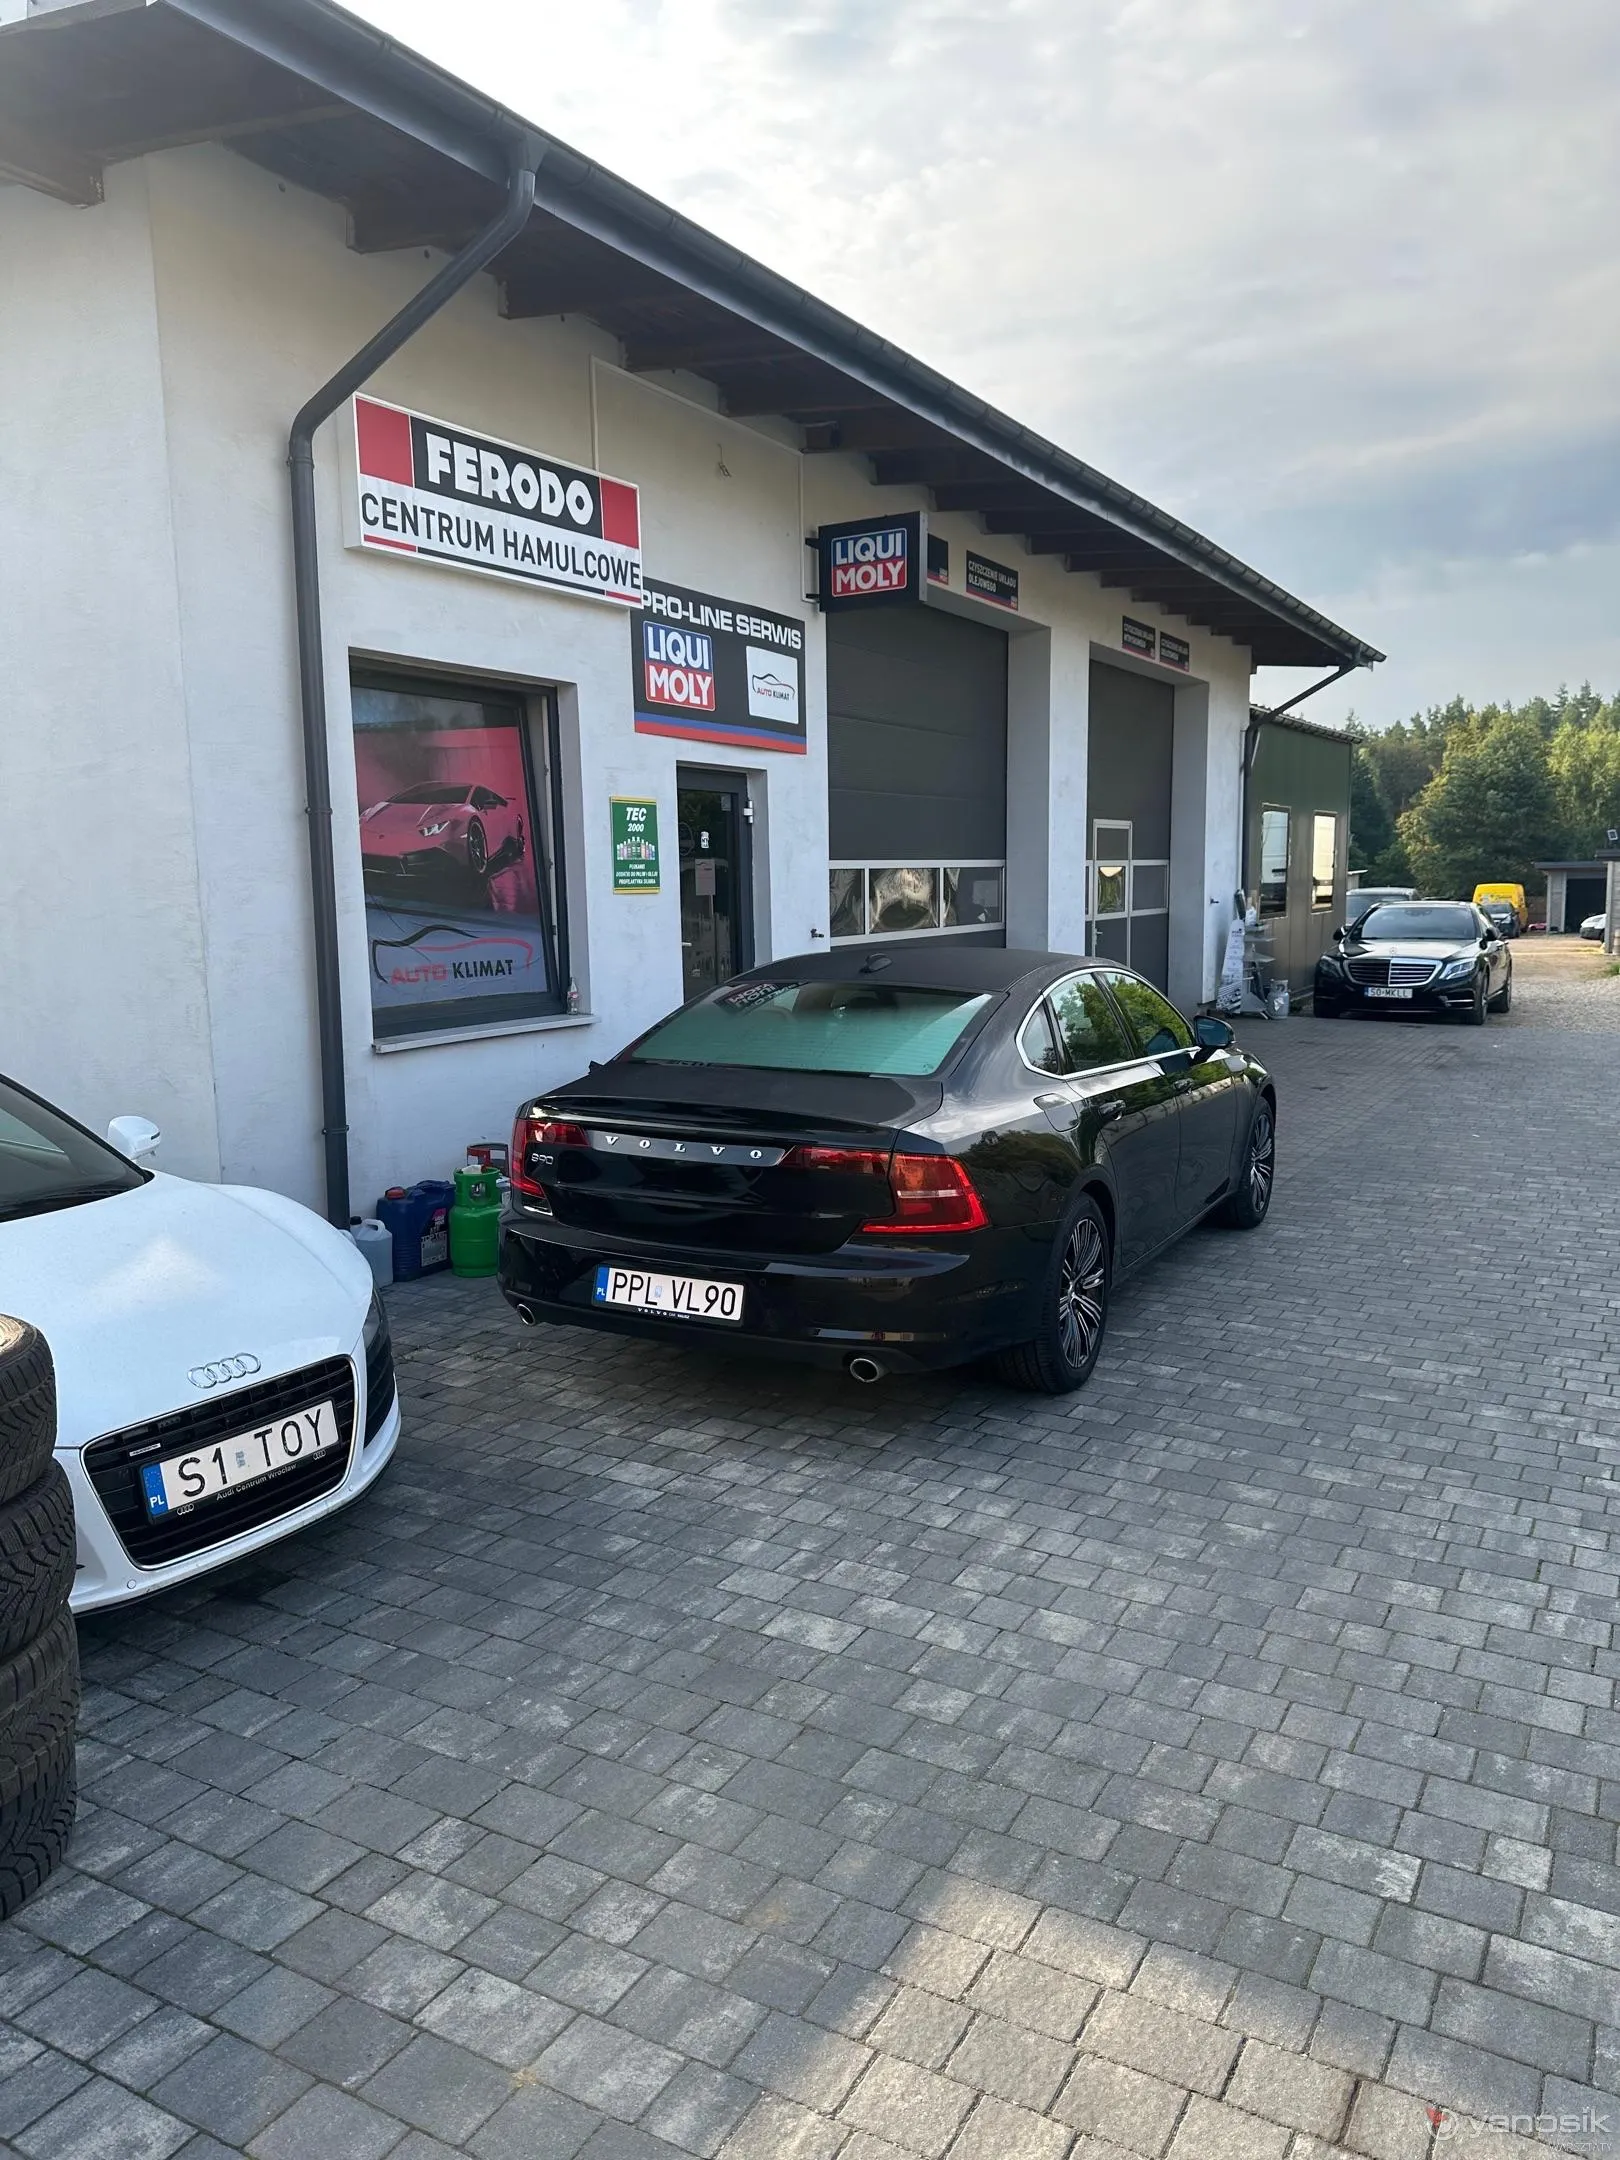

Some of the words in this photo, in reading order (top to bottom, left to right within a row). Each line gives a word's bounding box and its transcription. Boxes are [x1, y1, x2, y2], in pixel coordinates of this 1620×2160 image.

[426, 432, 593, 526] FERODO
[361, 492, 494, 555] CENTRUM
[503, 528, 641, 590] HAMULCOWE
[836, 532, 902, 565] LIQUI
[836, 561, 904, 593] MOLY
[642, 589, 733, 633] PRO-LINE
[736, 614, 801, 649] SERWIS
[648, 626, 710, 669] LIQUI
[649, 665, 712, 706] MOLY
[757, 687, 772, 697] AUTO
[626, 807, 647, 821] TEC
[627, 823, 645, 832] 2000
[391, 964, 448, 985] AUTO
[453, 959, 513, 980] KLIMAT
[531, 1153, 554, 1165] S90
[605, 1135, 762, 1159] VOLVO
[596, 1287, 606, 1296] PL
[612, 1272, 658, 1305] PPL
[672, 1280, 736, 1316] VL90
[638, 1307, 668, 1316] VOLVO
[150, 1494, 165, 1509] PL
[178, 1447, 228, 1497] S1
[254, 1408, 321, 1467] TOY
[216, 1488, 234, 1501] Audi
[236, 1474, 267, 1493] Centrum
